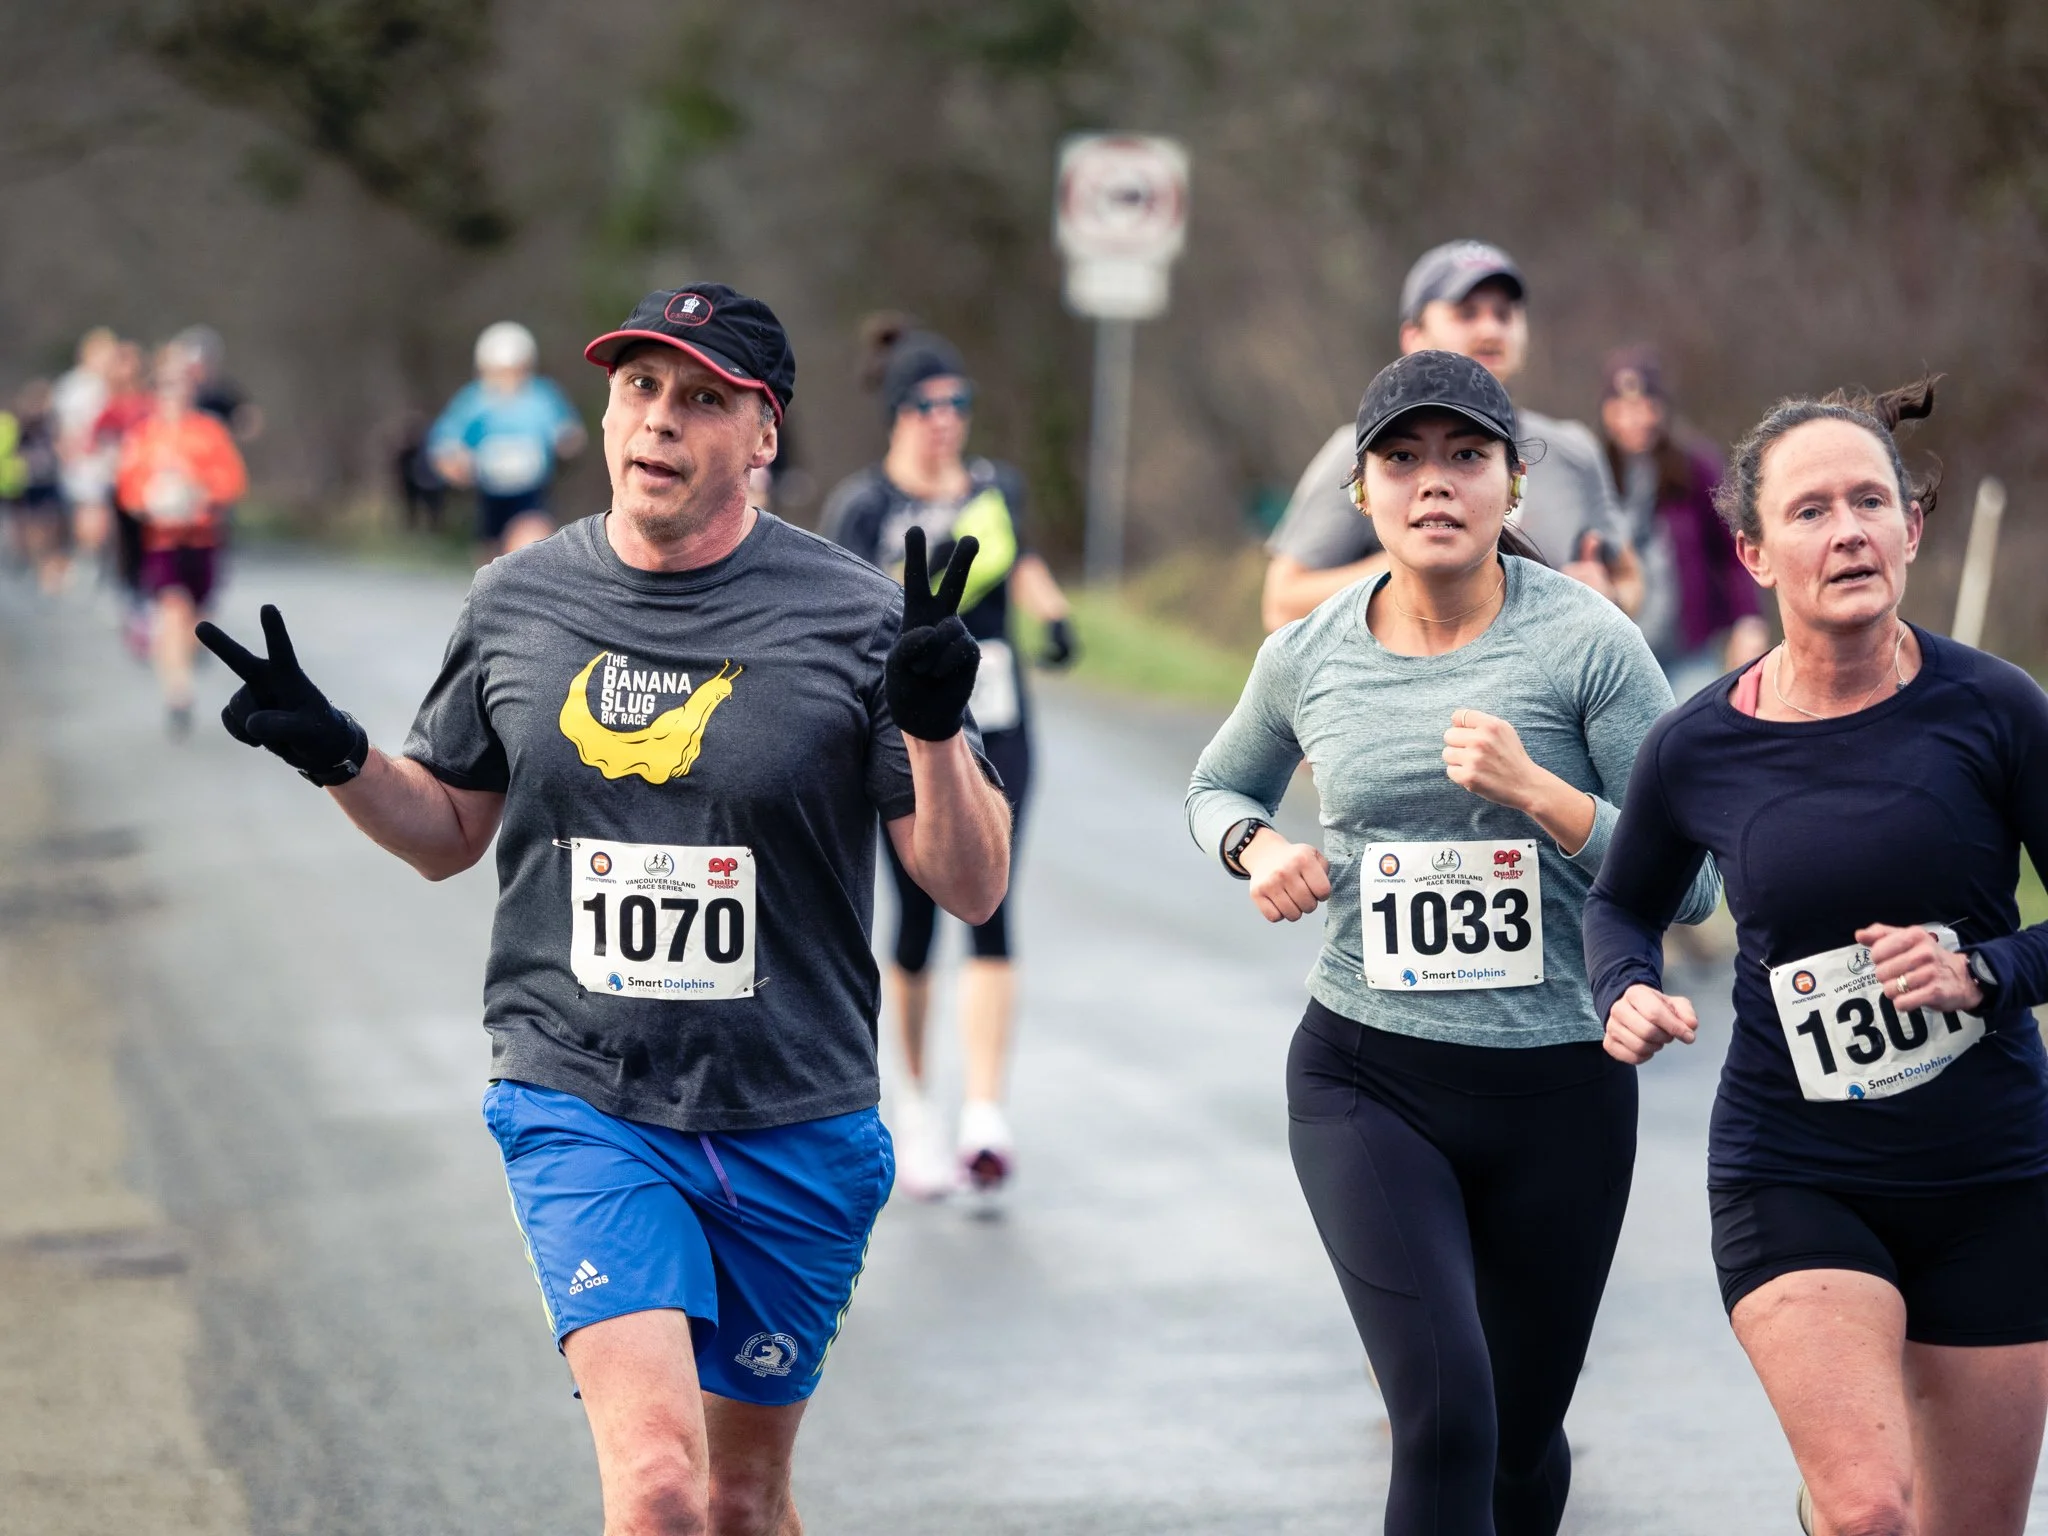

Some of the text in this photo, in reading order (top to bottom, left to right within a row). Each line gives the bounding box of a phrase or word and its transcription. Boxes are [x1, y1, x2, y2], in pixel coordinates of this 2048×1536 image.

[606, 652, 628, 667] THE
[602, 665, 692, 695] BANANA
[600, 688, 656, 714] SLUG
[601, 710, 648, 726] 8K RACE
[1414, 873, 1483, 883] VANCOUVER ISLAND
[1493, 869, 1523, 878] Quality
[625, 878, 696, 889] VANCOUVER ISLAND
[657, 884, 683, 892] SERIES
[707, 878, 740, 887] Quality
[1426, 878, 1471, 887] RACE SERIES
[582, 892, 745, 964] 1070
[1372, 888, 1532, 956] 1033
[1834, 973, 1876, 993] VANCOUVER
[1847, 982, 1866, 994] RACE
[569, 1274, 609, 1296] addas
